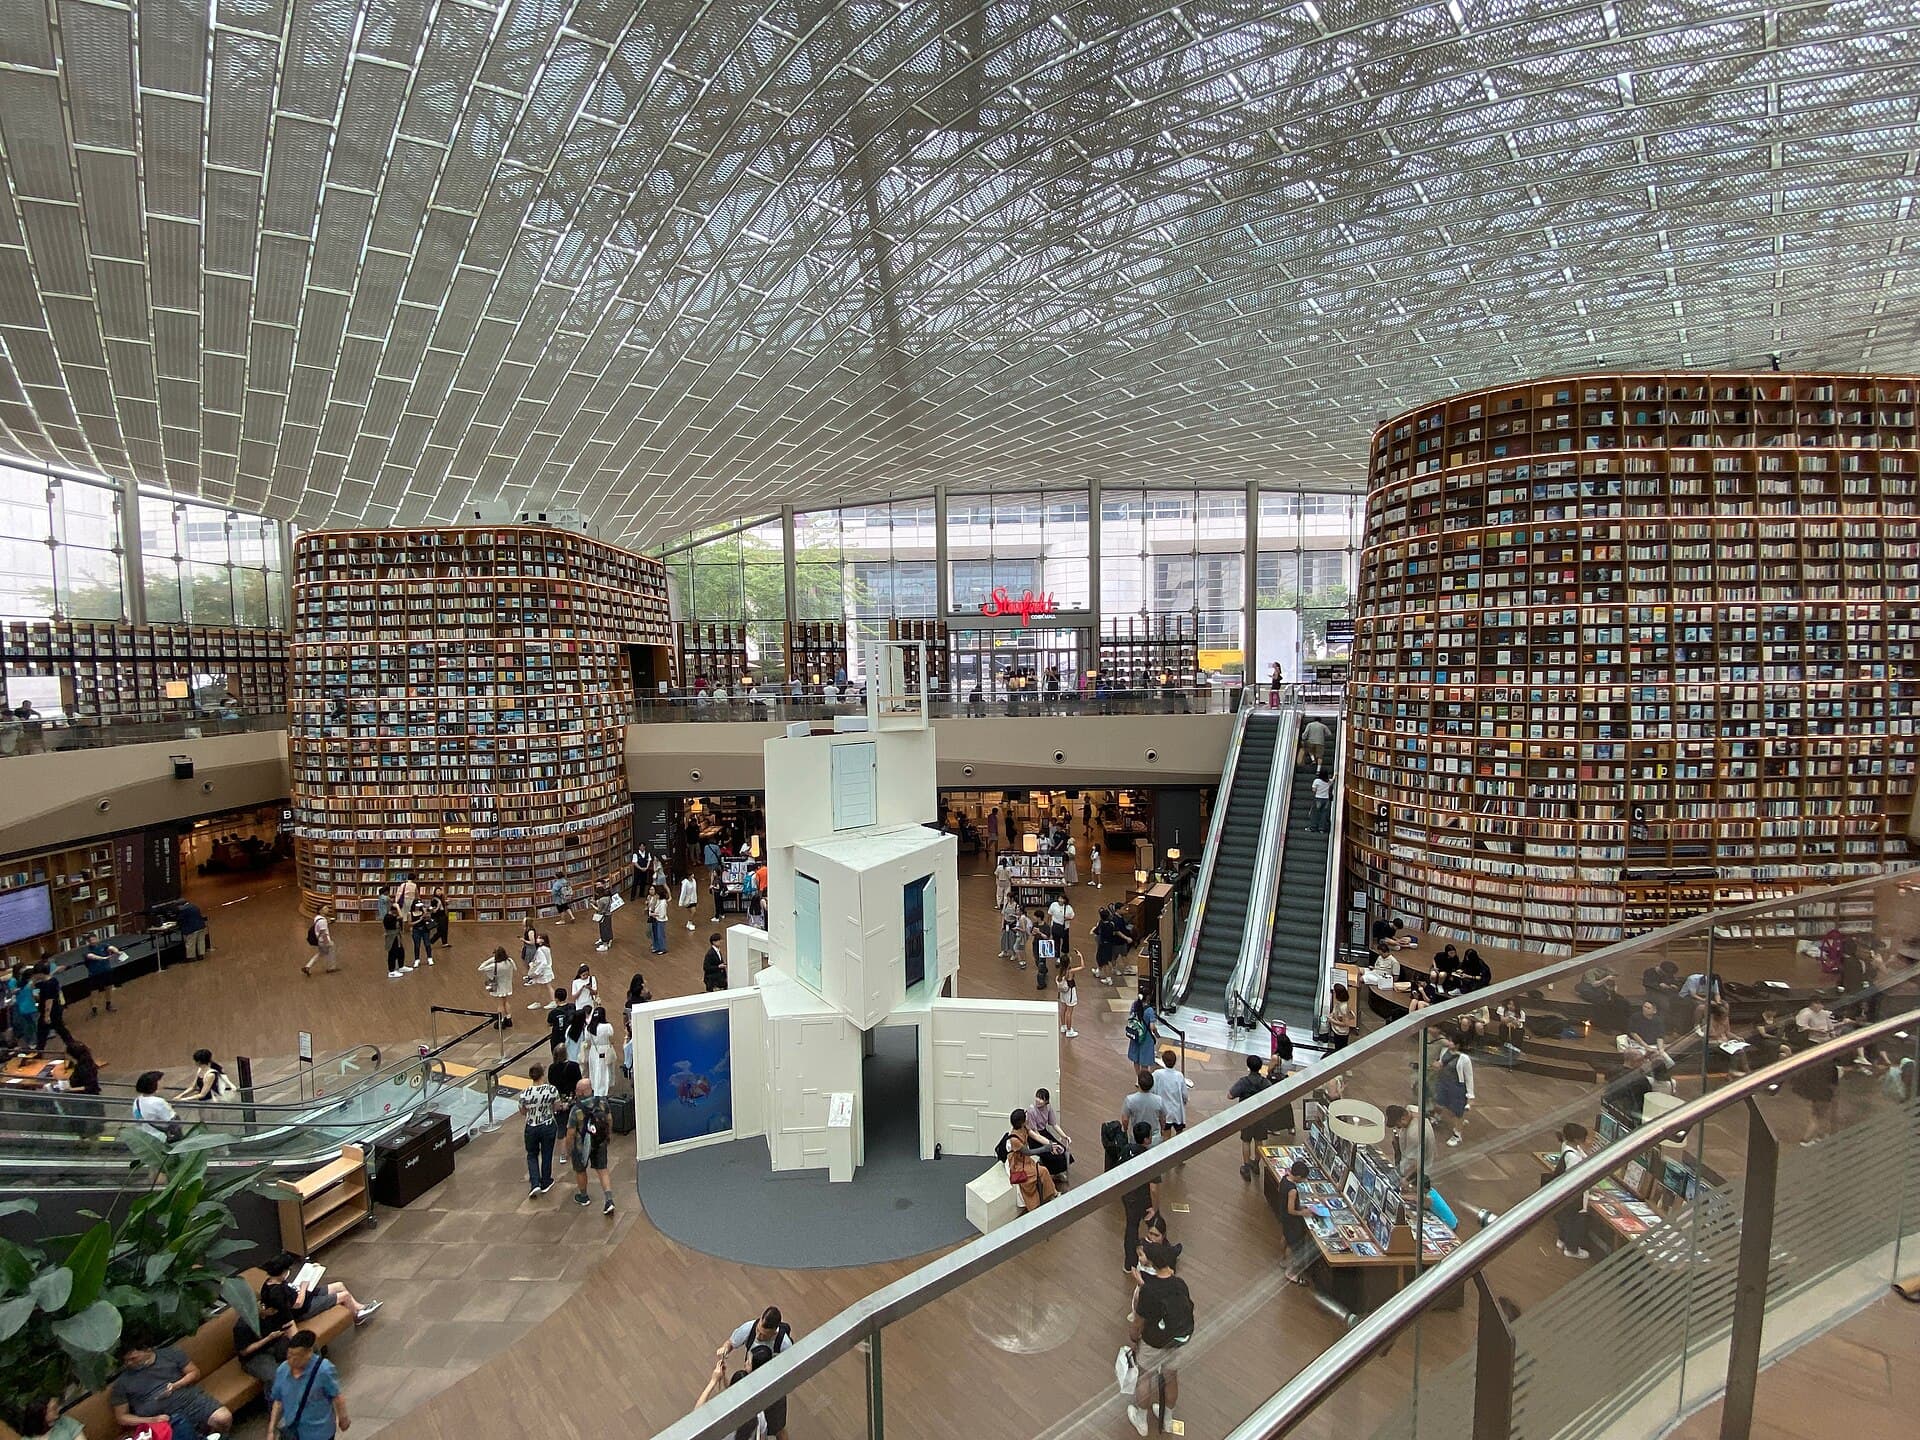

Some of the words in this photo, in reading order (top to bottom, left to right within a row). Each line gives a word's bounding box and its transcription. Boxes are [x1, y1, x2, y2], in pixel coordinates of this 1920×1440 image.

[982, 585, 1055, 627] Starfield
[283, 810, 292, 820] B
[1380, 806, 1388, 817] C
[1634, 807, 1643, 821] C
[492, 812, 498, 823] B
